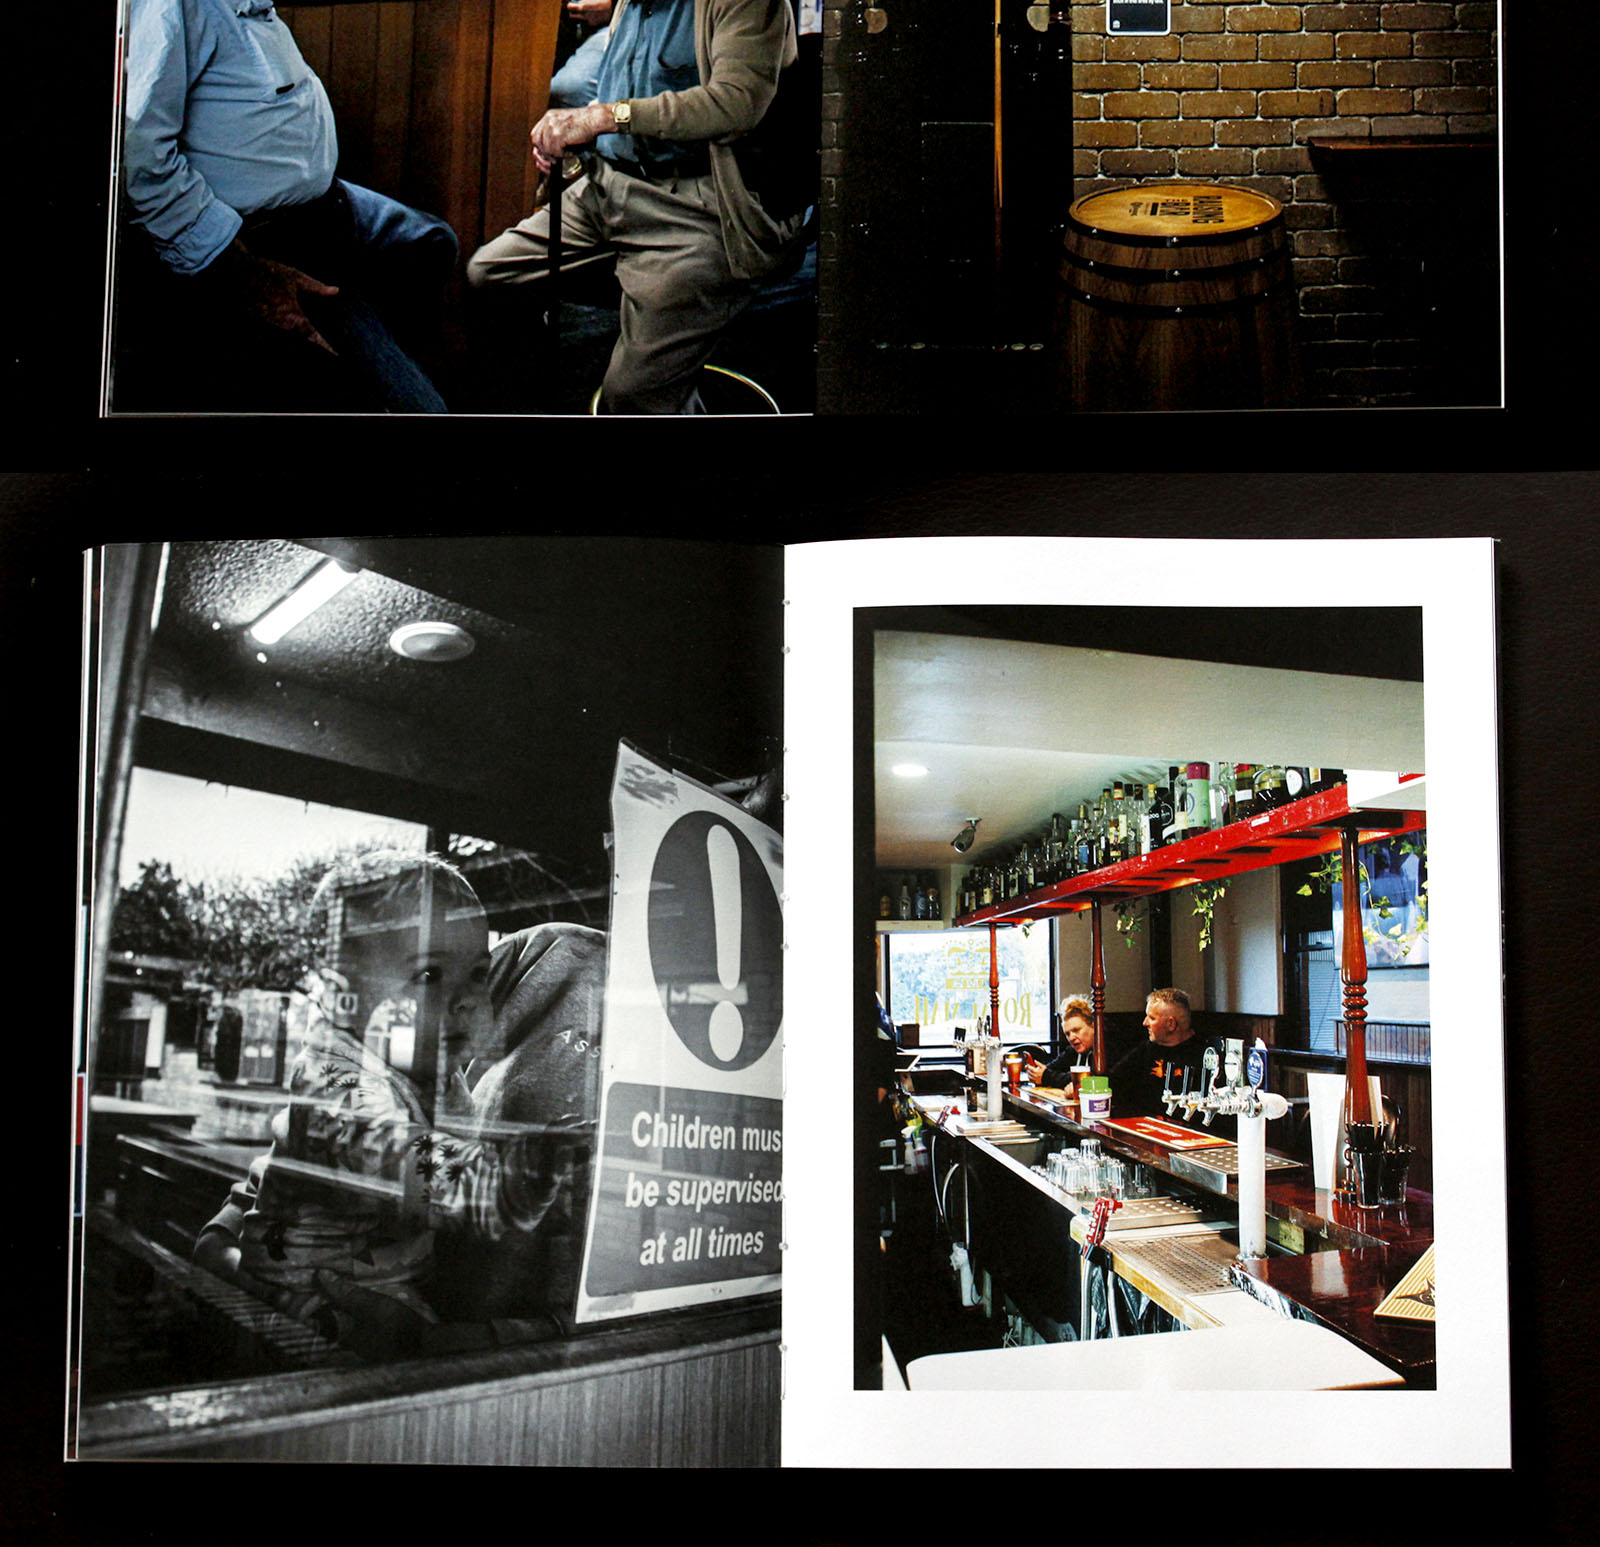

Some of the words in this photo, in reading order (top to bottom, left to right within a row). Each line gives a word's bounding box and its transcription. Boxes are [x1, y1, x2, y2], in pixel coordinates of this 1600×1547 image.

[631, 1110, 736, 1150] Children
[625, 1172, 660, 1208] be
[640, 1231, 668, 1266] at
[672, 1227, 703, 1262] all
[708, 1226, 764, 1259] times
